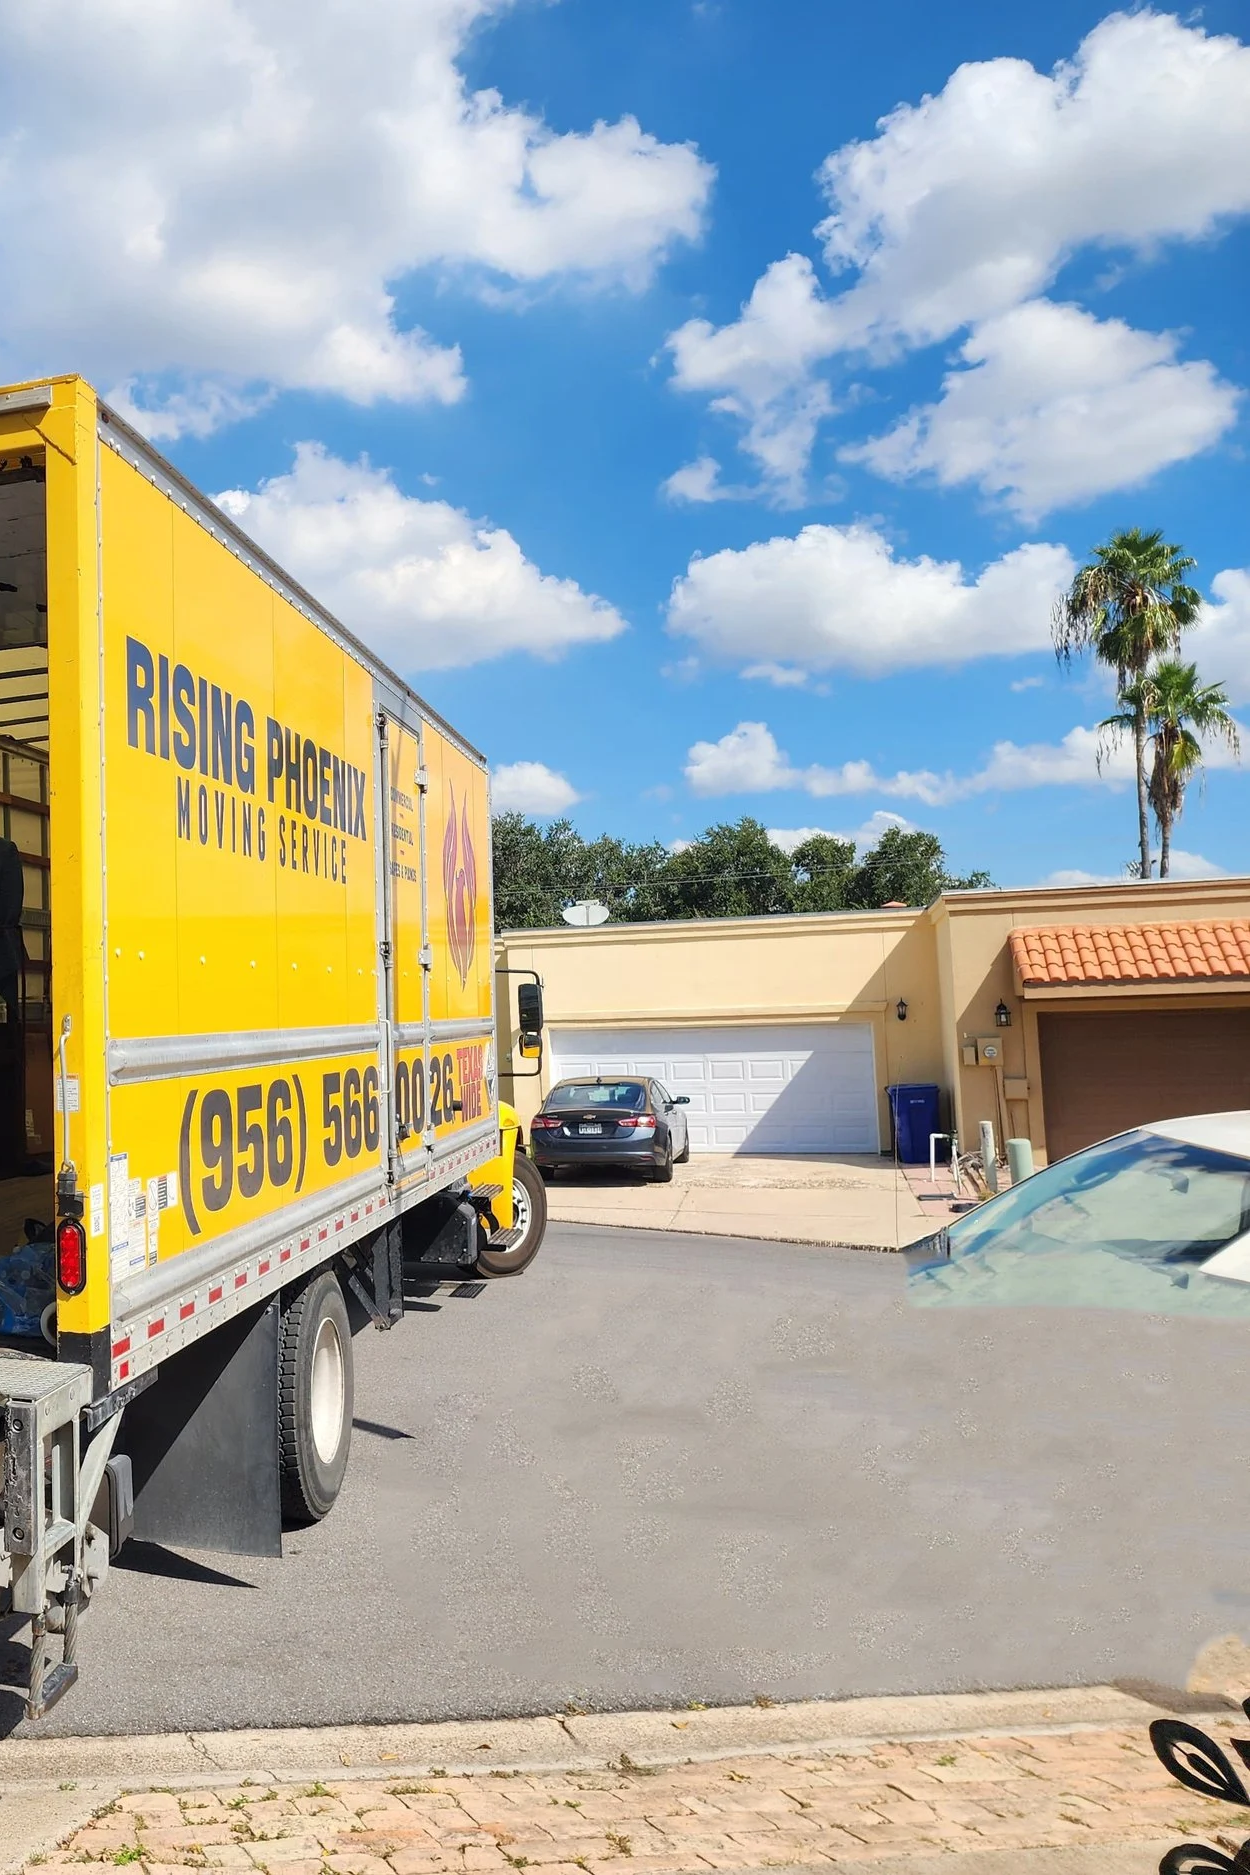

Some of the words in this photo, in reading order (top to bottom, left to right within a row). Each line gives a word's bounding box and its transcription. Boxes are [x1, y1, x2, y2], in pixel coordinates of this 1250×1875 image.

[126, 634, 255, 795] RISING
[266, 715, 367, 842] PHOENIX
[176, 775, 266, 862] MOVING
[279, 814, 347, 885] SERVICE
[456, 1044, 483, 1087] TEXAS
[460, 1081, 482, 1123] WIDE
[178, 1073, 307, 1237] (956)
